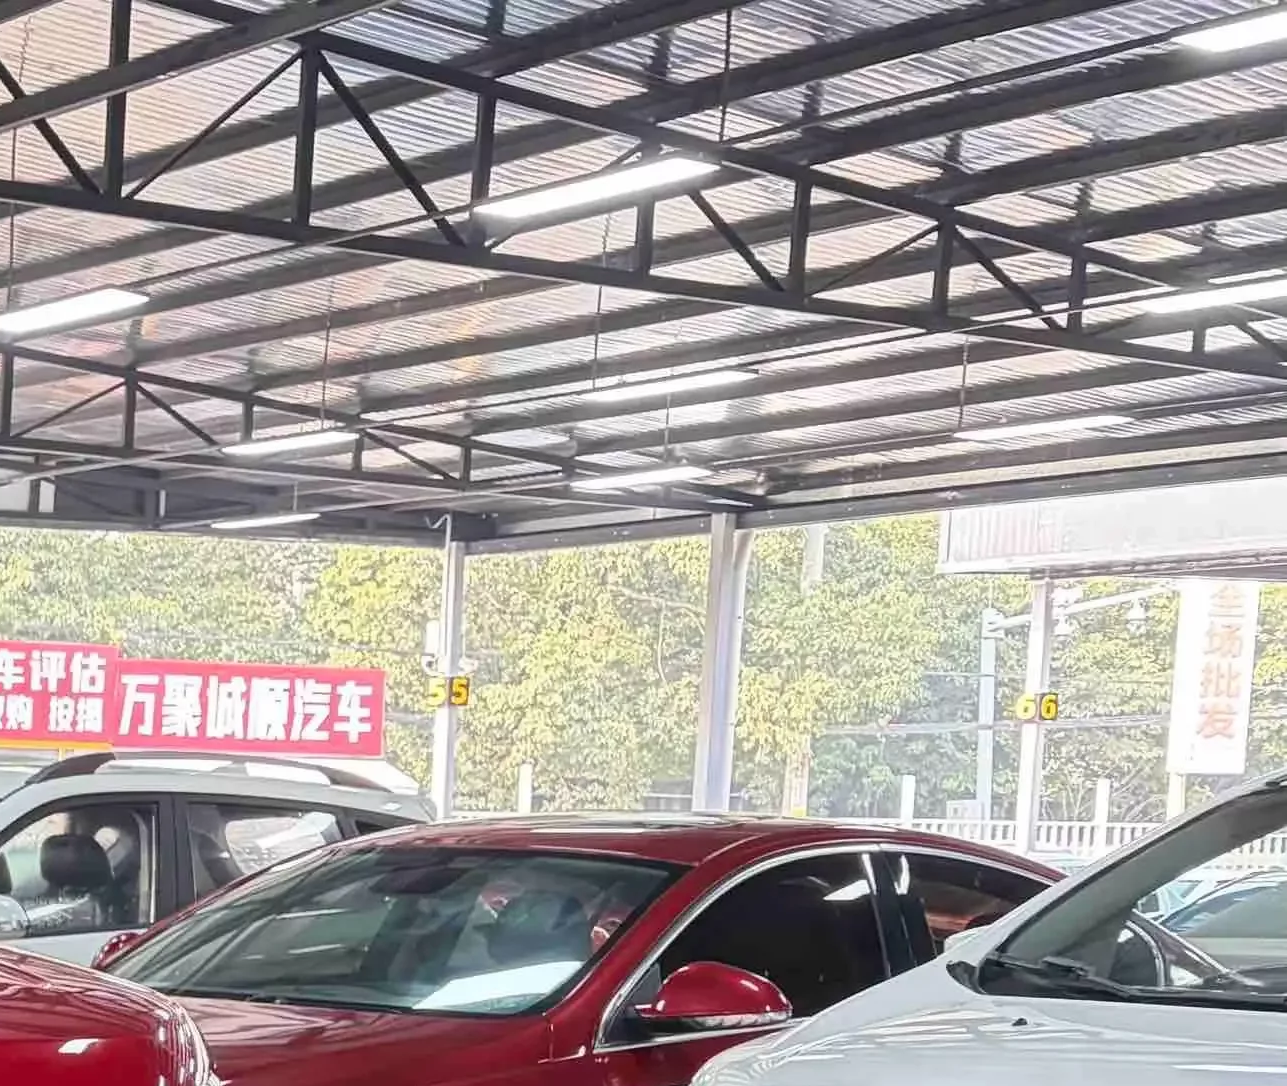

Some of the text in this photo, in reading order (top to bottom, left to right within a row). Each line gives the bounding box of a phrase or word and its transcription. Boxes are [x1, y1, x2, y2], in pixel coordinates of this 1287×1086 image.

[48, 696, 104, 733] 按揭
[118, 674, 374, 743] 万聚诚顺汽车
